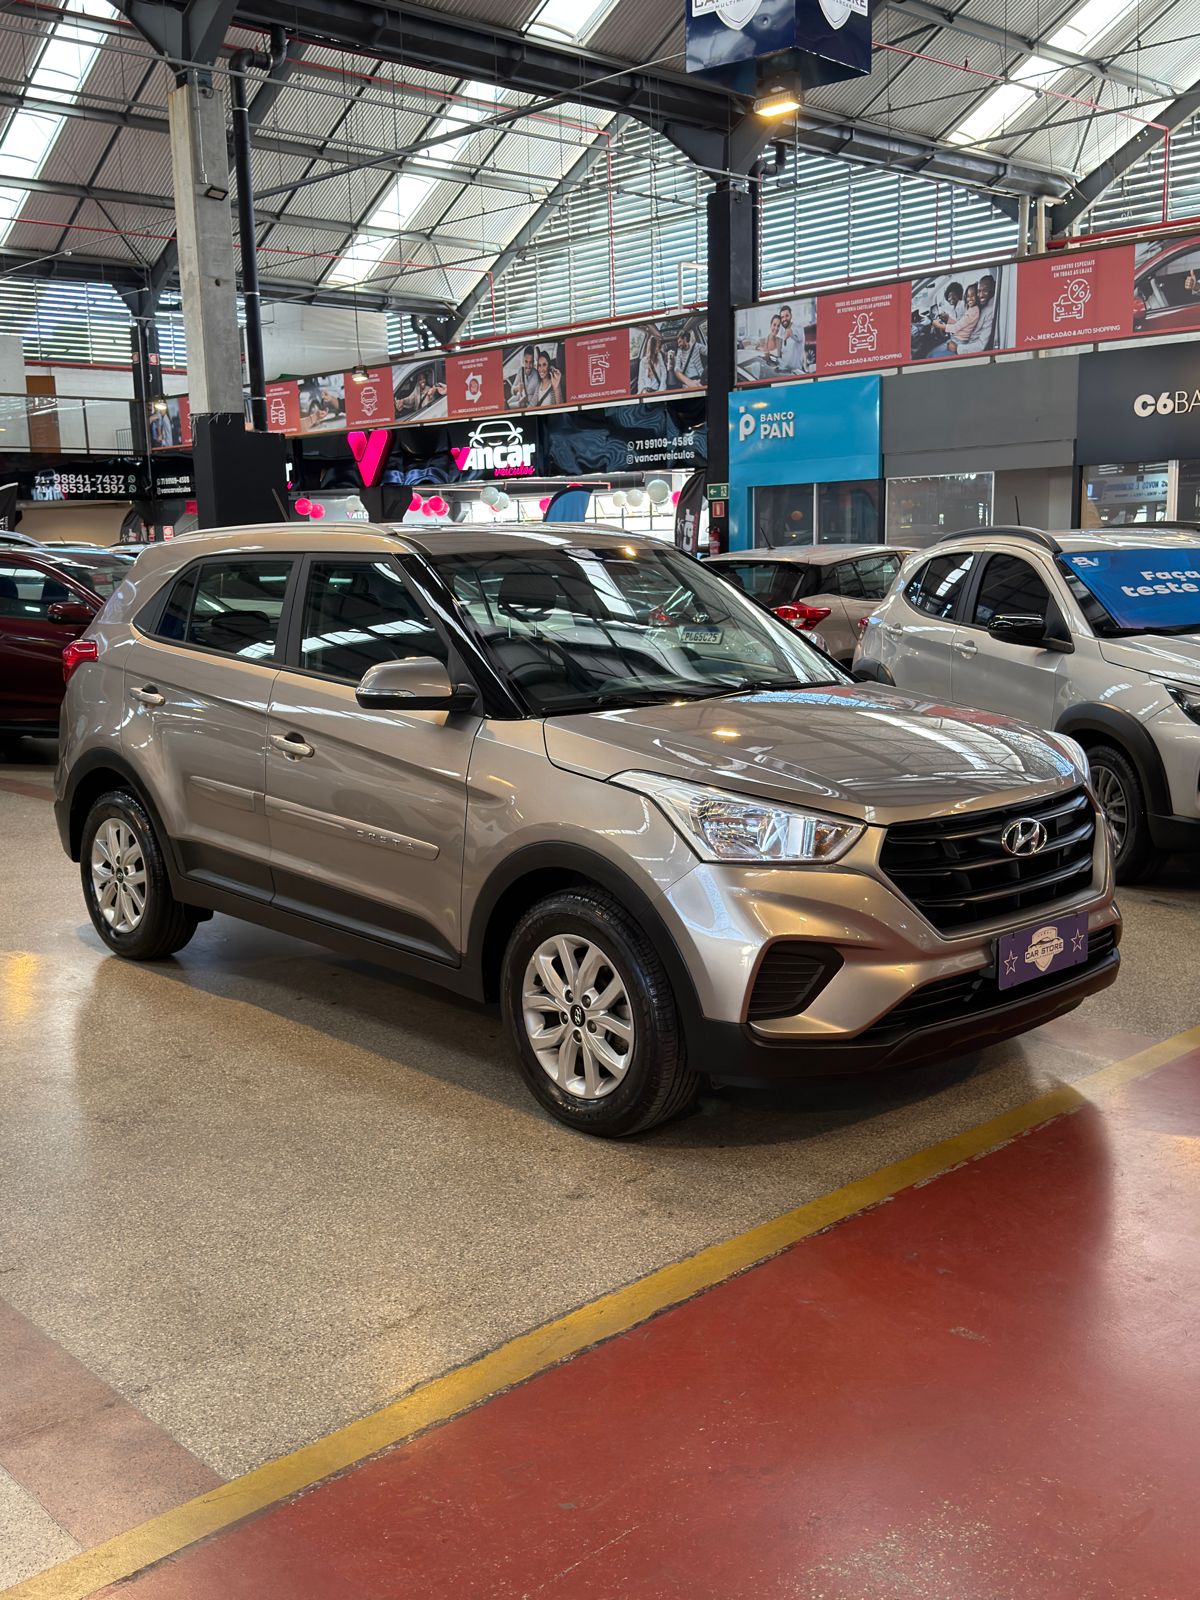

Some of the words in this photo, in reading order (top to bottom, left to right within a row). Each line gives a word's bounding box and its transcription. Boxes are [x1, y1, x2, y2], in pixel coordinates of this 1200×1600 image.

[1077, 327, 1092, 336] AUTO
[1093, 324, 1121, 334] SHOPPING
[760, 411, 795, 422] BANCO
[760, 421, 795, 440] PAN
[634, 449, 695, 463] vancarveiculos
[53, 473, 125, 485] 98841-7437
[53, 483, 126, 494] 98534-1392
[1121, 581, 1200, 597] teste
[1025, 949, 1039, 960] CAR
[1041, 942, 1062, 955] STORE
